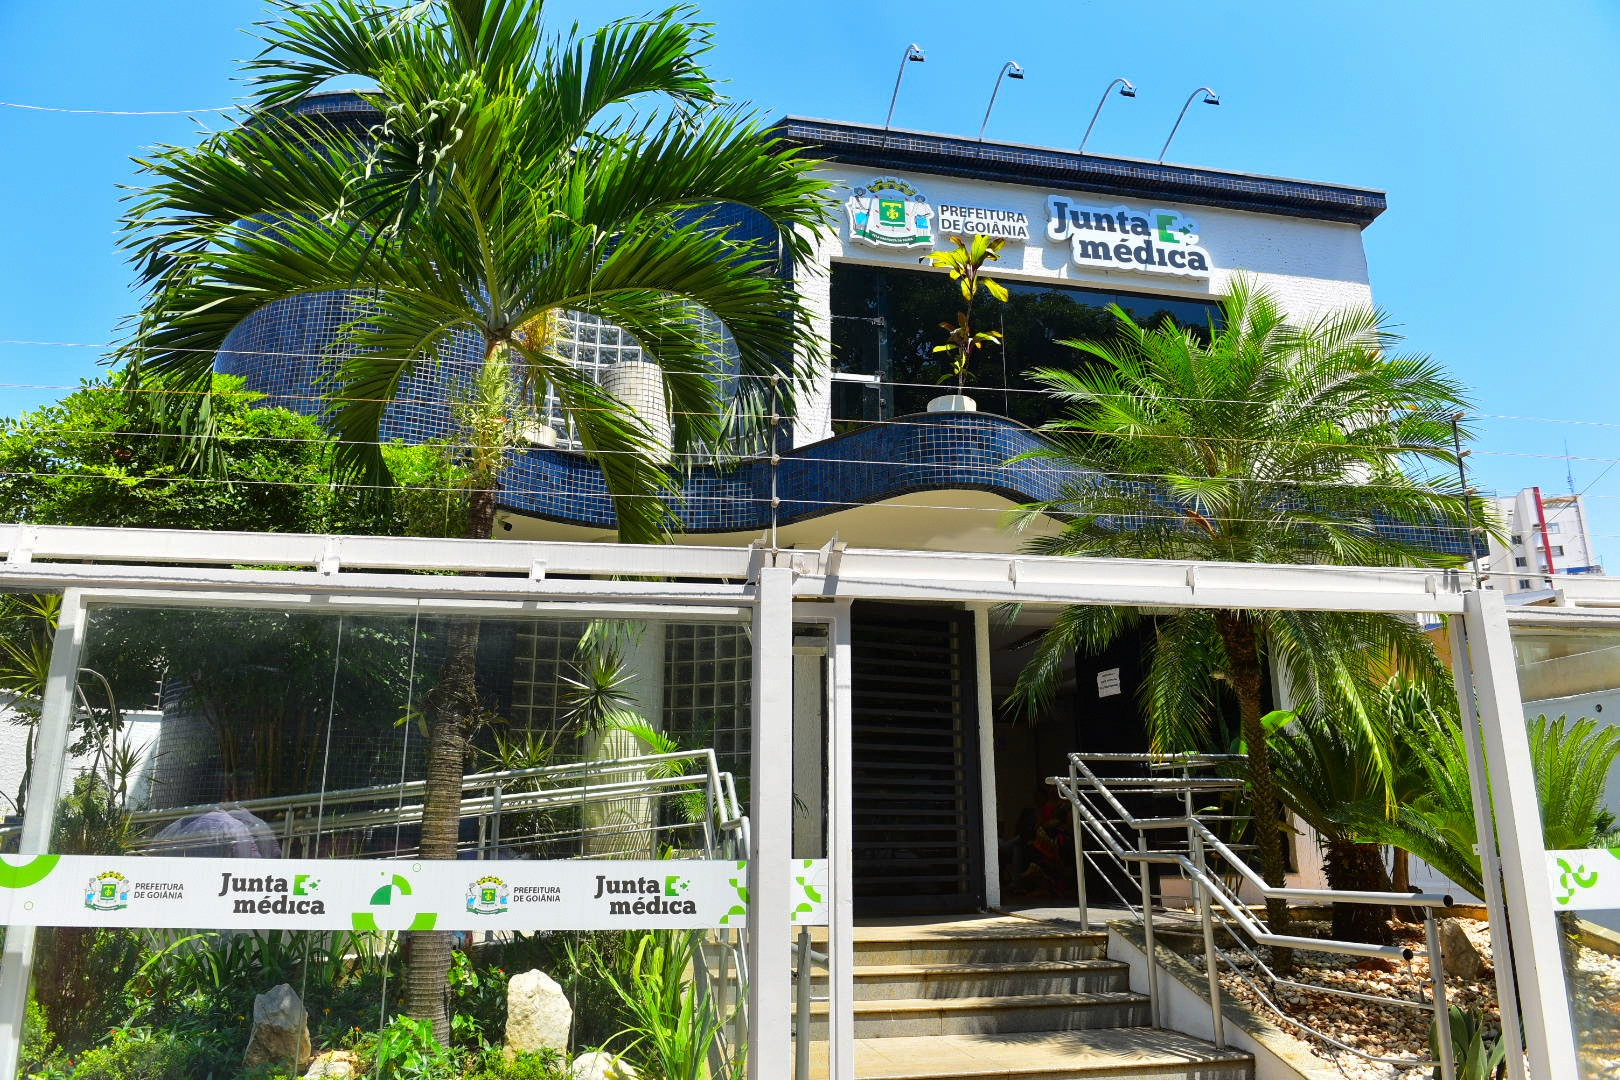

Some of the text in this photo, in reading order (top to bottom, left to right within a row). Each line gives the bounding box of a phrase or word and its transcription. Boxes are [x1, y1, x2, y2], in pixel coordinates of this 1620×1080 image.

[940, 205, 1026, 223] PREFEITURA
[1054, 202, 1151, 236] Junta
[941, 219, 1026, 237] DE GOIÂNIA
[1079, 239, 1208, 271] médica
[135, 882, 184, 891] PREFEITURA
[218, 872, 288, 896] Junta
[513, 886, 561, 894] PREFEITURA
[594, 875, 660, 899] Junta
[133, 890, 183, 899] DE GOIÂNIA
[513, 893, 561, 902] DE GOIÂNIA
[233, 895, 325, 914] médica
[609, 895, 697, 914] médica
